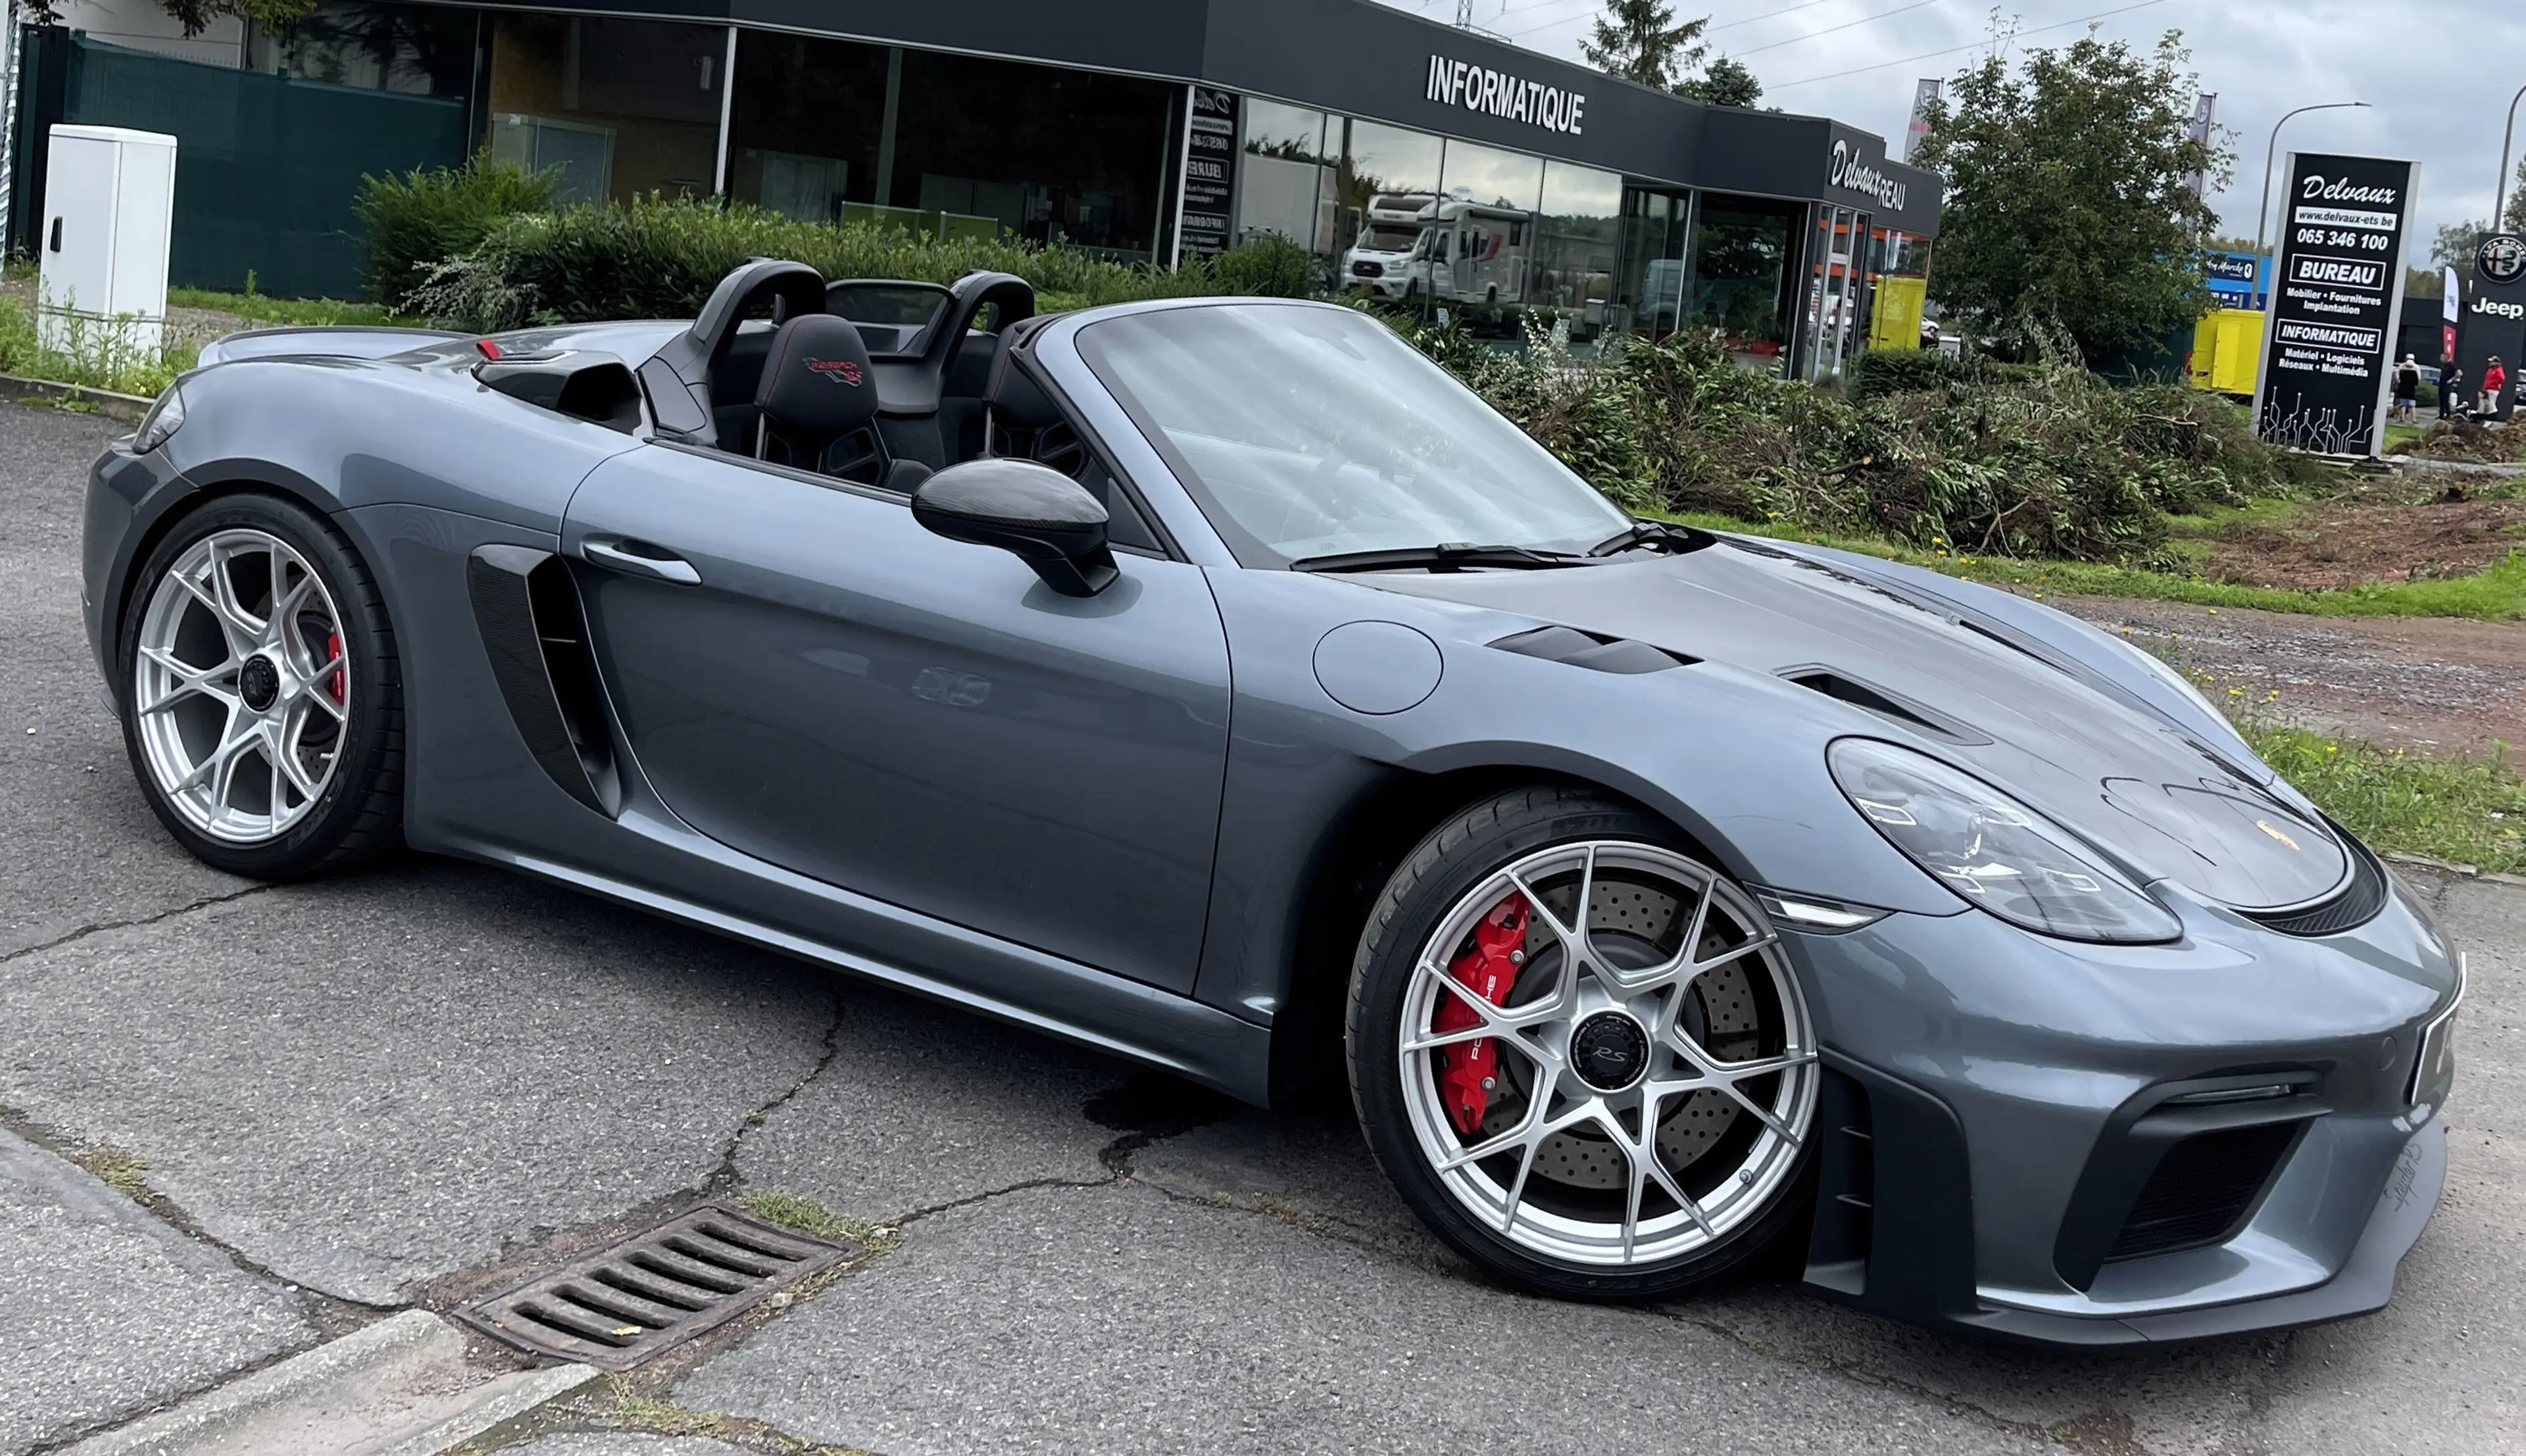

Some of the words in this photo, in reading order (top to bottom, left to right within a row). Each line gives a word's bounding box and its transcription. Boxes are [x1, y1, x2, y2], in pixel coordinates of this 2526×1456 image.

[1427, 55, 1585, 135] INFORMATIQUE
[1831, 139, 1882, 197] Delvaux
[1879, 178, 1906, 211] REAU
[2303, 175, 2396, 205] Delvaux
[2297, 228, 2325, 245] 065
[2327, 231, 2356, 247] 346
[2361, 233, 2389, 251] 100
[2299, 260, 2377, 284] BUREAU
[2286, 287, 2322, 300] Mobilier
[2329, 291, 2382, 306] Fournitures
[2304, 300, 2360, 315] Implantation
[2471, 297, 2524, 320] Jeep
[2281, 325, 2376, 347] INFORMATIQUE
[2279, 358, 2314, 371] Réseaux
[2321, 363, 2369, 377] Multimédia
[2285, 347, 2319, 360] Matériel
[2326, 352, 2365, 366] Logiciels
[1471, 975, 1497, 1060] POHE
[1593, 1046, 1628, 1063] RS
